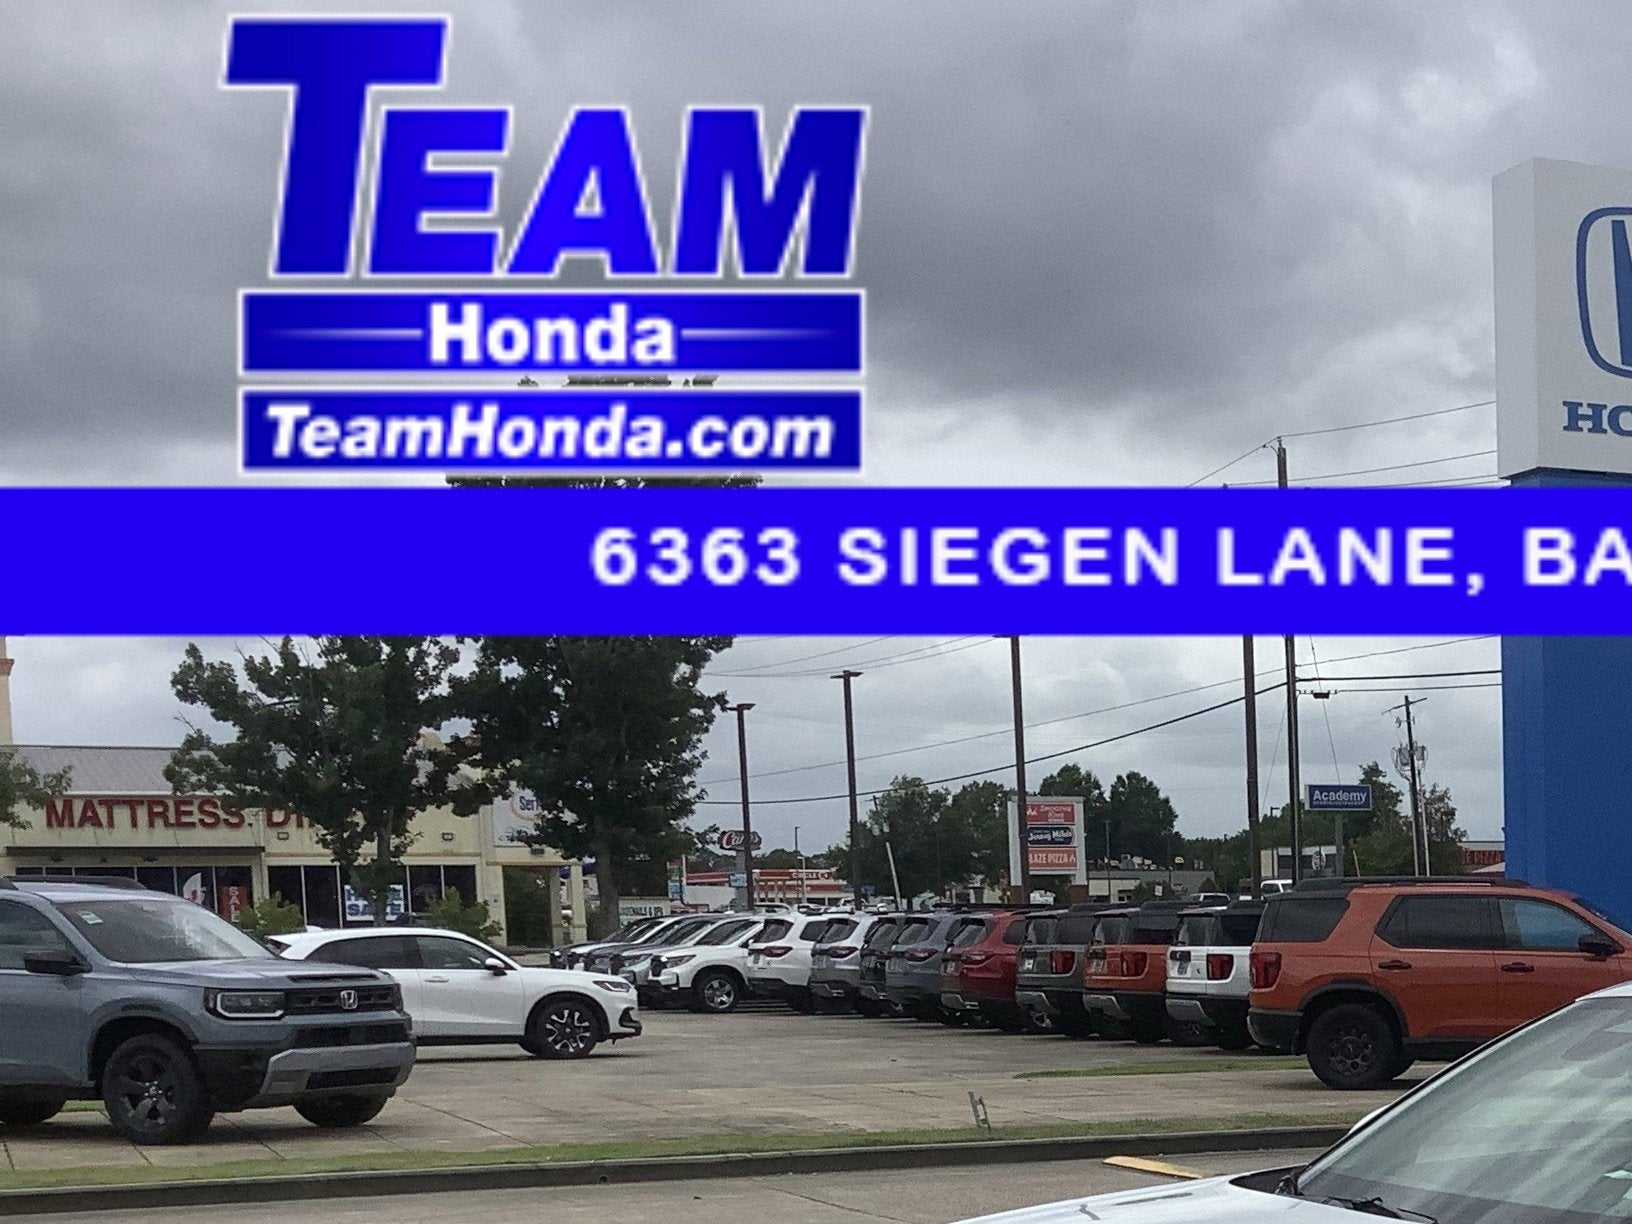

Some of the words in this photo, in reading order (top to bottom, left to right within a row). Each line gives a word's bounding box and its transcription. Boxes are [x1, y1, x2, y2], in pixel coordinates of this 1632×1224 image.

[1313, 789, 1367, 804] Academy
[46, 799, 246, 829] MATTRESS
[1029, 853, 1047, 864] LAZE
[1047, 853, 1068, 864] PIZZA
